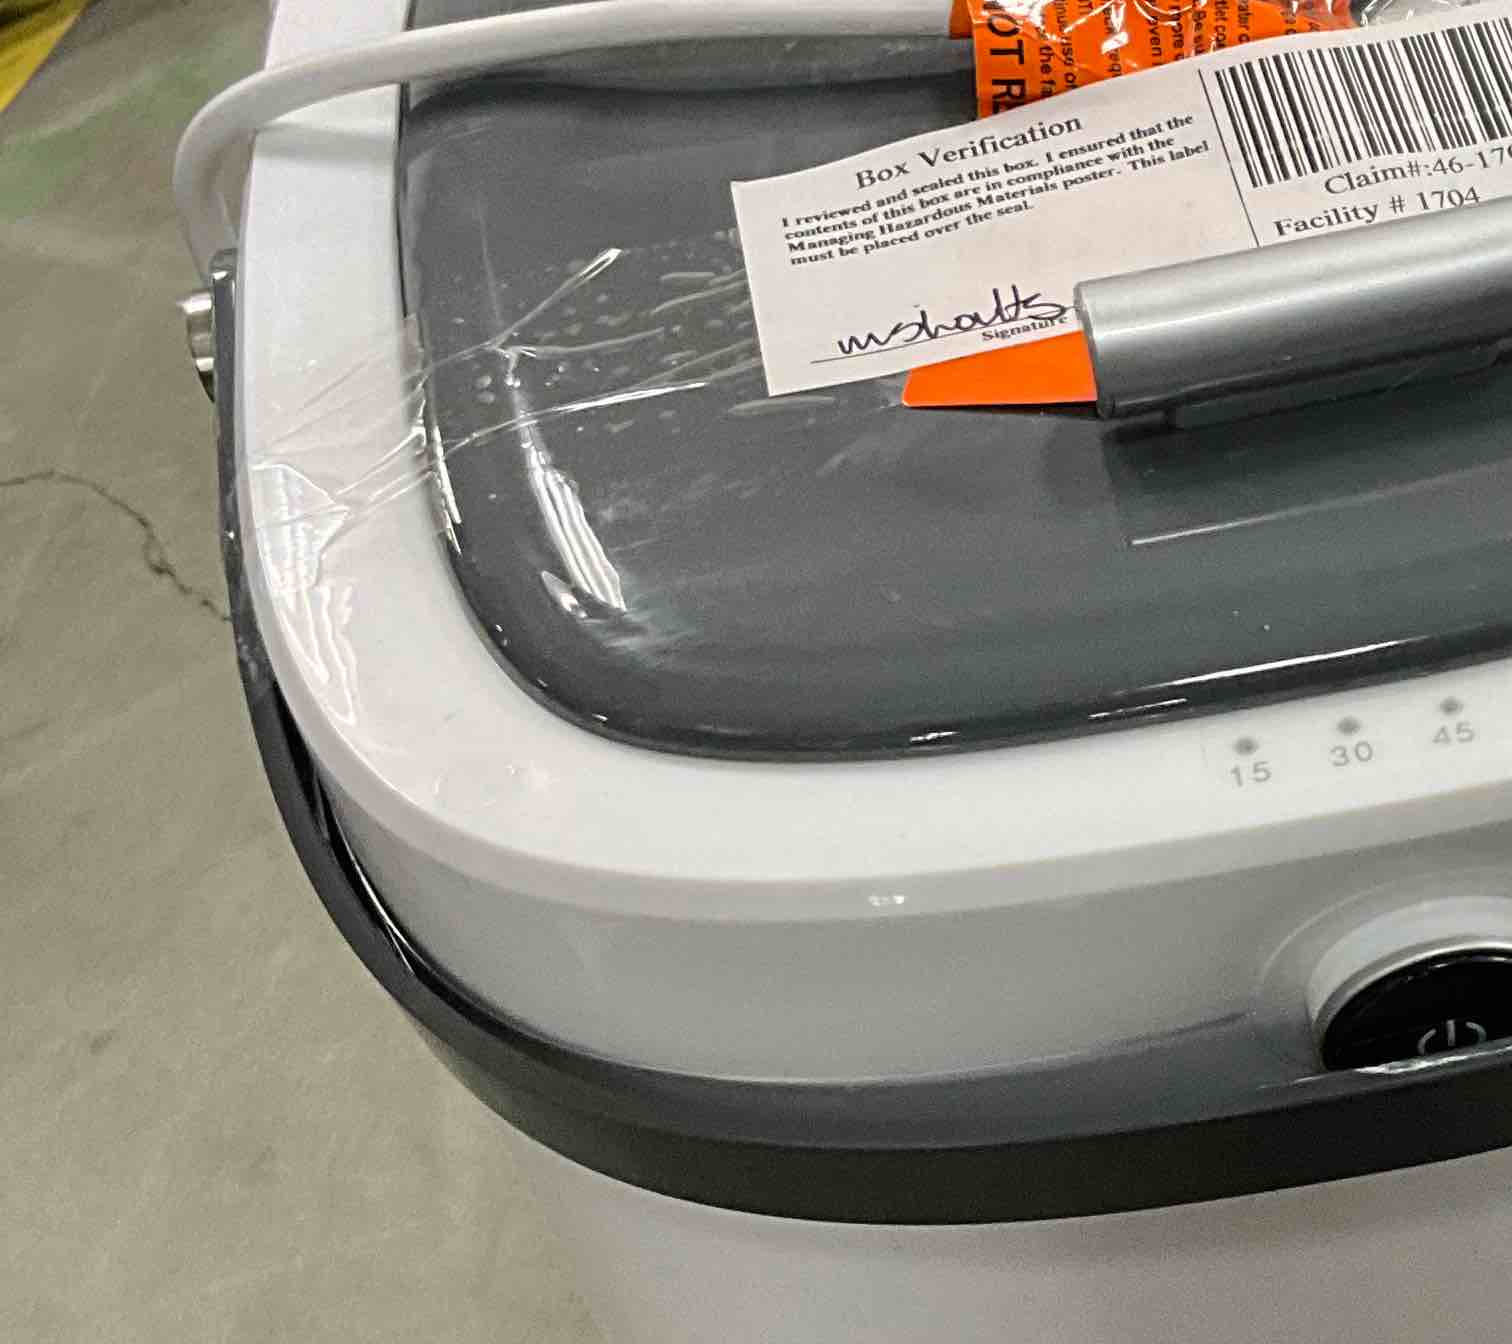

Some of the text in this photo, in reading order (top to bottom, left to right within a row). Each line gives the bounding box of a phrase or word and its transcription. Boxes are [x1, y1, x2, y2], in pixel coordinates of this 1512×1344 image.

[784, 136, 1176, 241] contents of this box are in compliance with the
[795, 200, 872, 227] reviewed
[876, 189, 909, 208] and
[912, 173, 964, 196] sealed
[967, 165, 999, 183] this
[1003, 157, 1040, 174] box.
[1058, 133, 1126, 160] ensured
[1128, 122, 1164, 141] that
[1166, 114, 1193, 131] the
[856, 117, 1083, 190] Box Verification
[787, 139, 1210, 254] Managing Hazardous Materials poster. This label
[1273, 185, 1482, 237] Facility # 1704
[789, 200, 1035, 267] must be placed over the seal.
[980, 315, 1069, 342] Signature
[1230, 760, 1272, 788] 15
[1329, 740, 1374, 768] 30
[1431, 721, 1476, 745] 45
